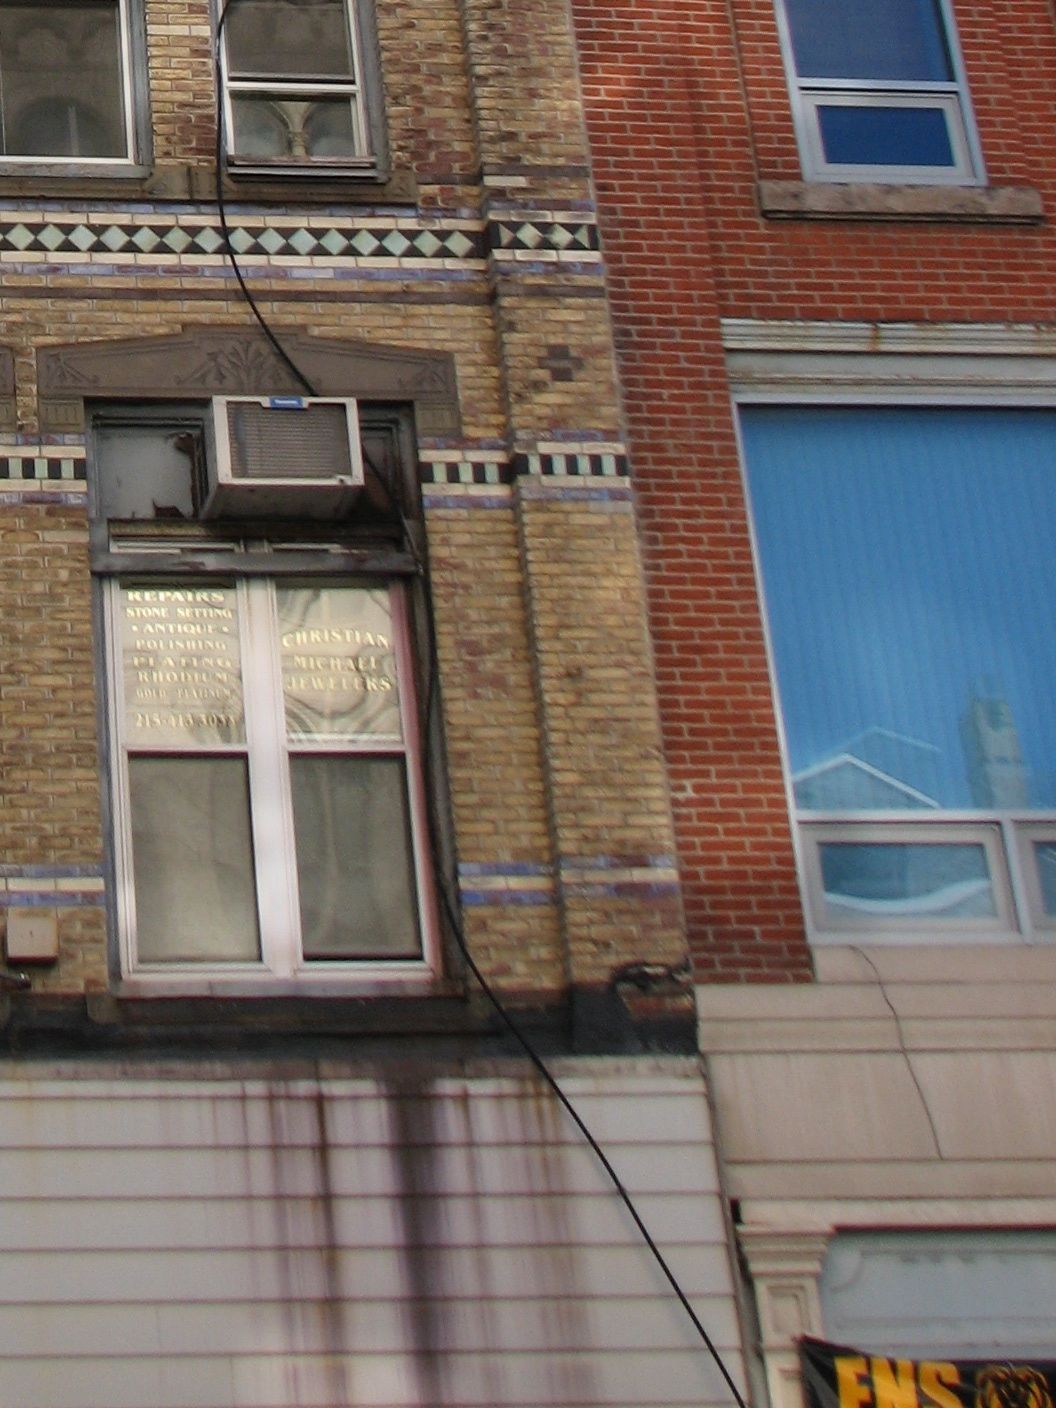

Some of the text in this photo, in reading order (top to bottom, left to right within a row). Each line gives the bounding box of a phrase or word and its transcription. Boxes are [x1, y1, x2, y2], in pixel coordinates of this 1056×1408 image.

[127, 590, 225, 603] REPAIRS
[126, 607, 233, 620] STONE SETTING
[142, 623, 216, 636] ANTIQUE
[135, 639, 227, 651] POLISHING
[281, 628, 390, 649] CHRISTIAN
[292, 654, 378, 672] MICHAEL
[286, 675, 393, 692] JEWELERS
